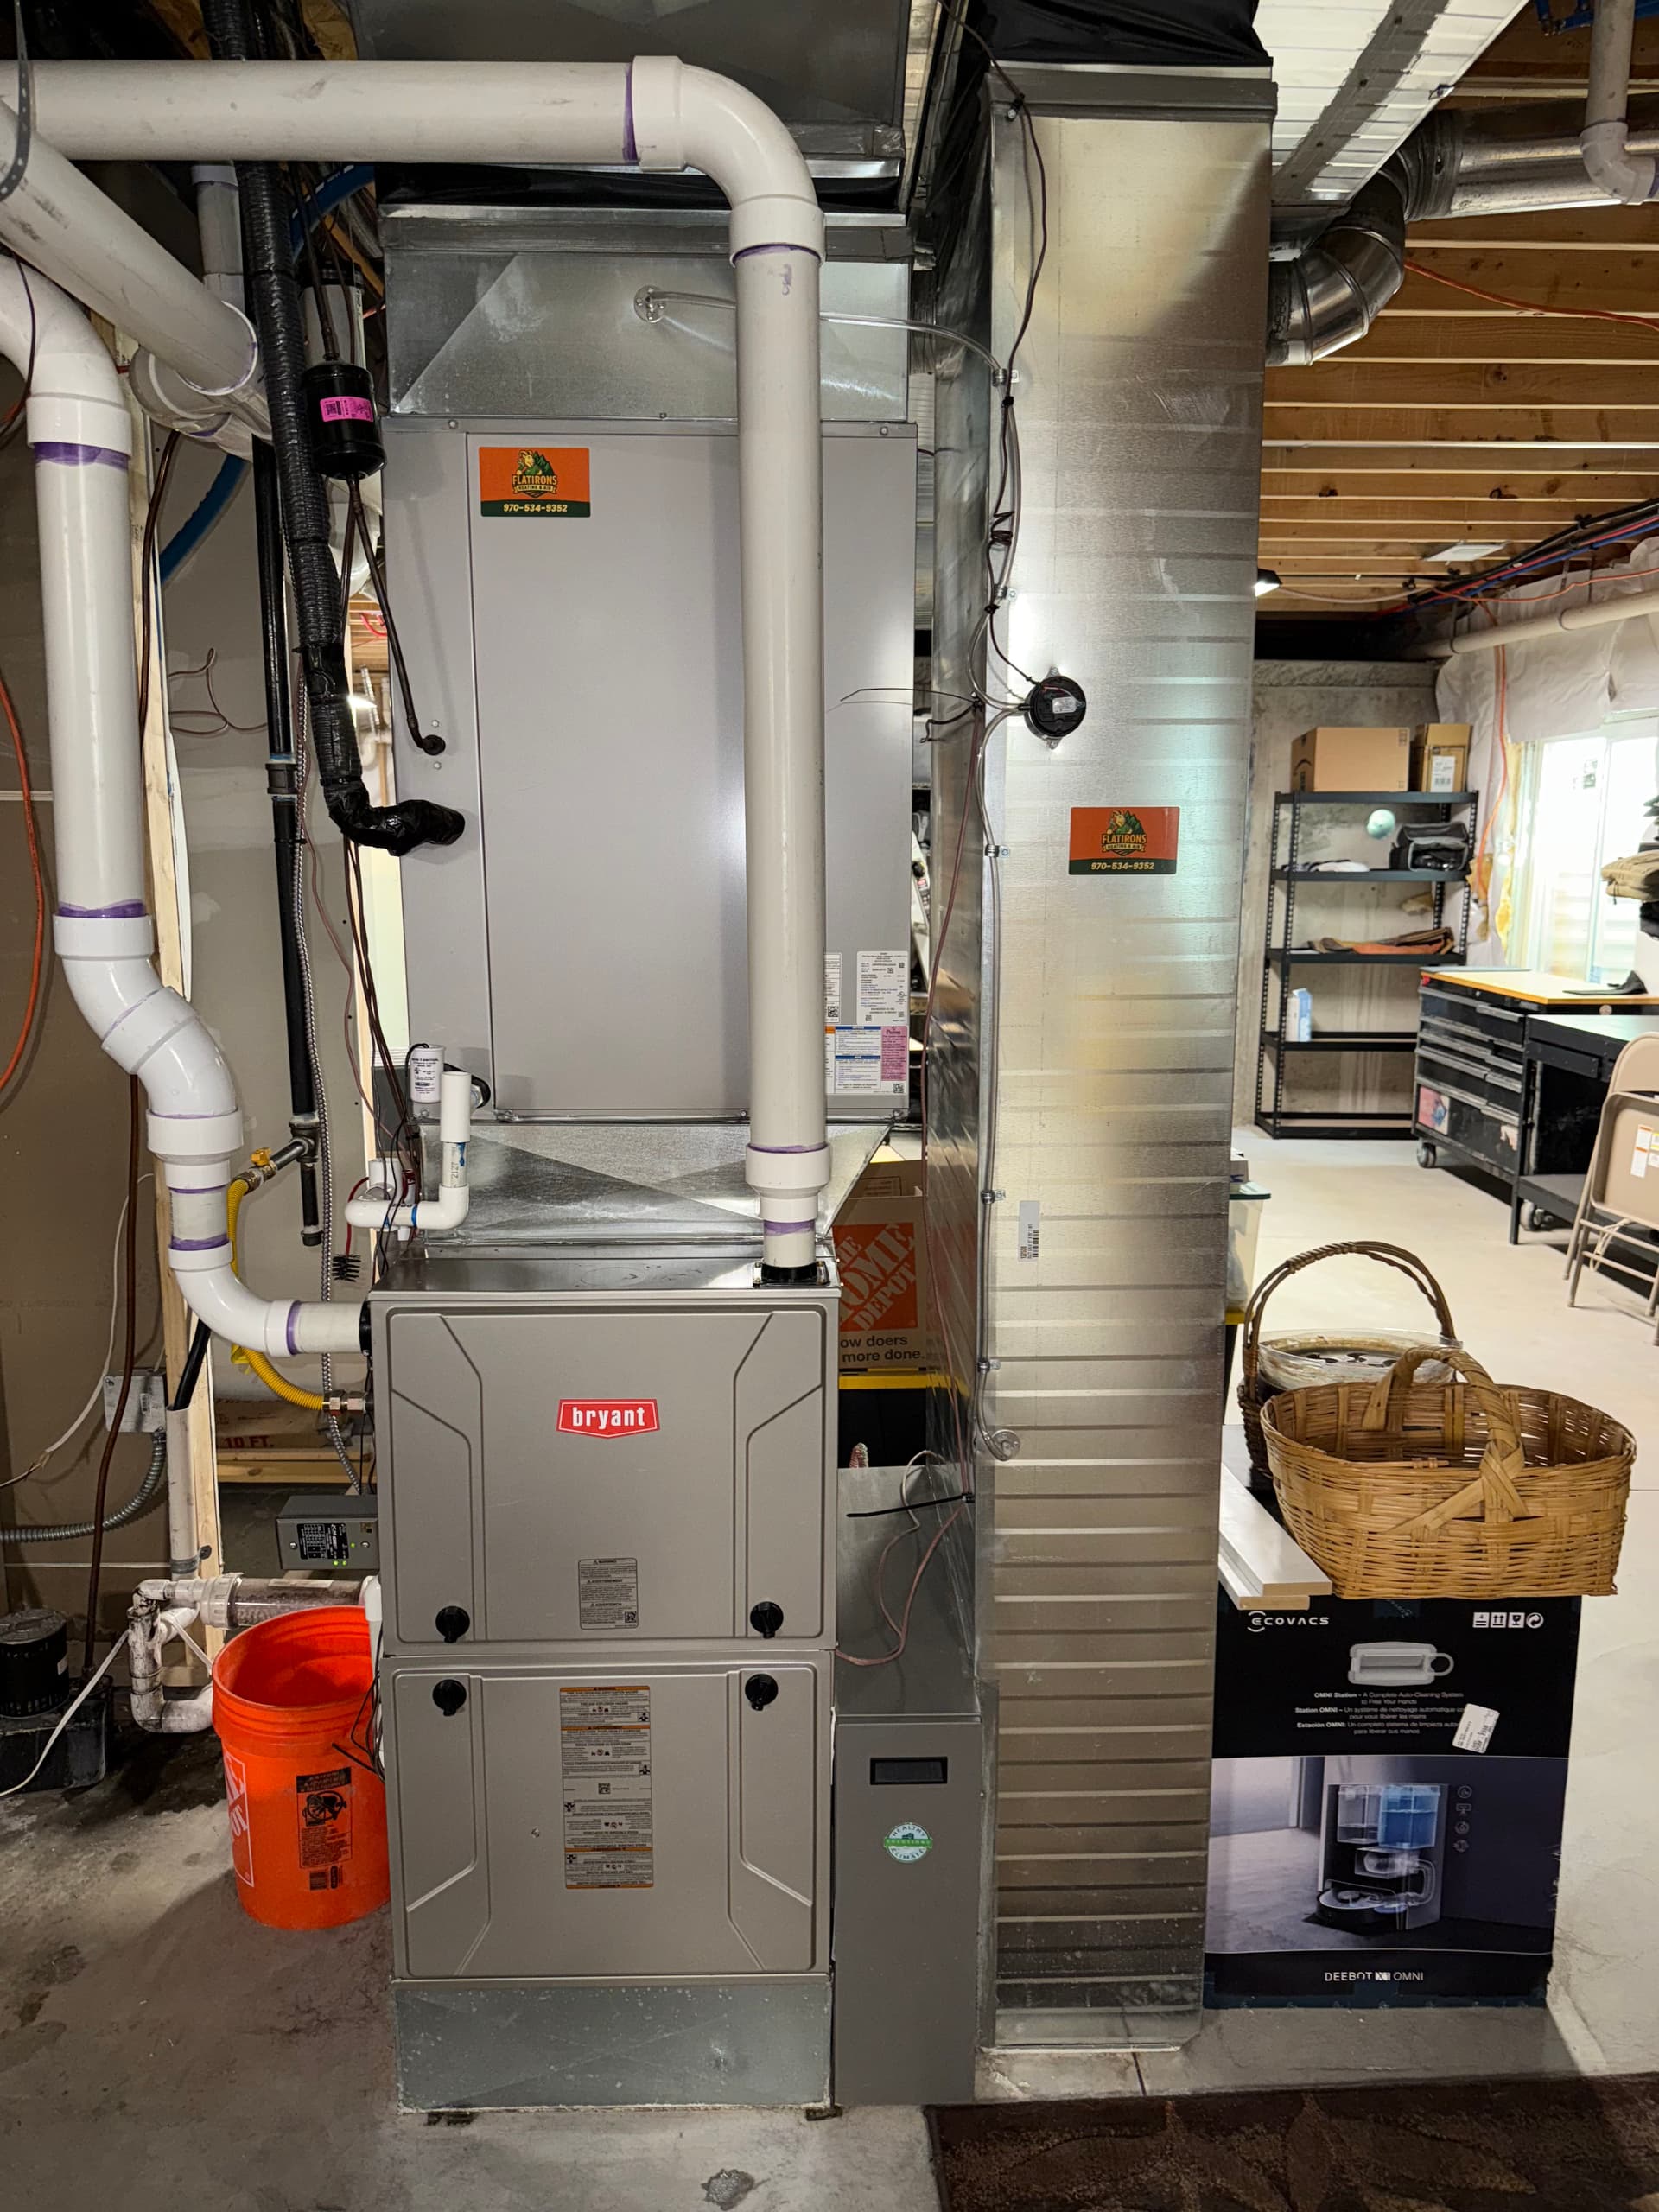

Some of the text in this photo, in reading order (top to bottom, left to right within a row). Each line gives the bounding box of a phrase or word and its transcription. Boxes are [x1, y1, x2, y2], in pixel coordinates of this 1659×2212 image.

[512, 475, 557, 485] FLATIRONS
[503, 504, 568, 512] 970-534-9352
[1102, 835, 1147, 843] FLATIRONS
[853, 1262, 917, 1331] DEPOT
[840, 1336, 908, 1349] ow doers
[842, 1349, 925, 1363] more done.
[572, 1407, 645, 1430] bryant
[249, 1435, 275, 1449] FT.
[891, 1825, 926, 1837] HEALTHY
[1324, 1971, 1373, 1981] DEEBOT
[1393, 1971, 1424, 1981] OMNI
